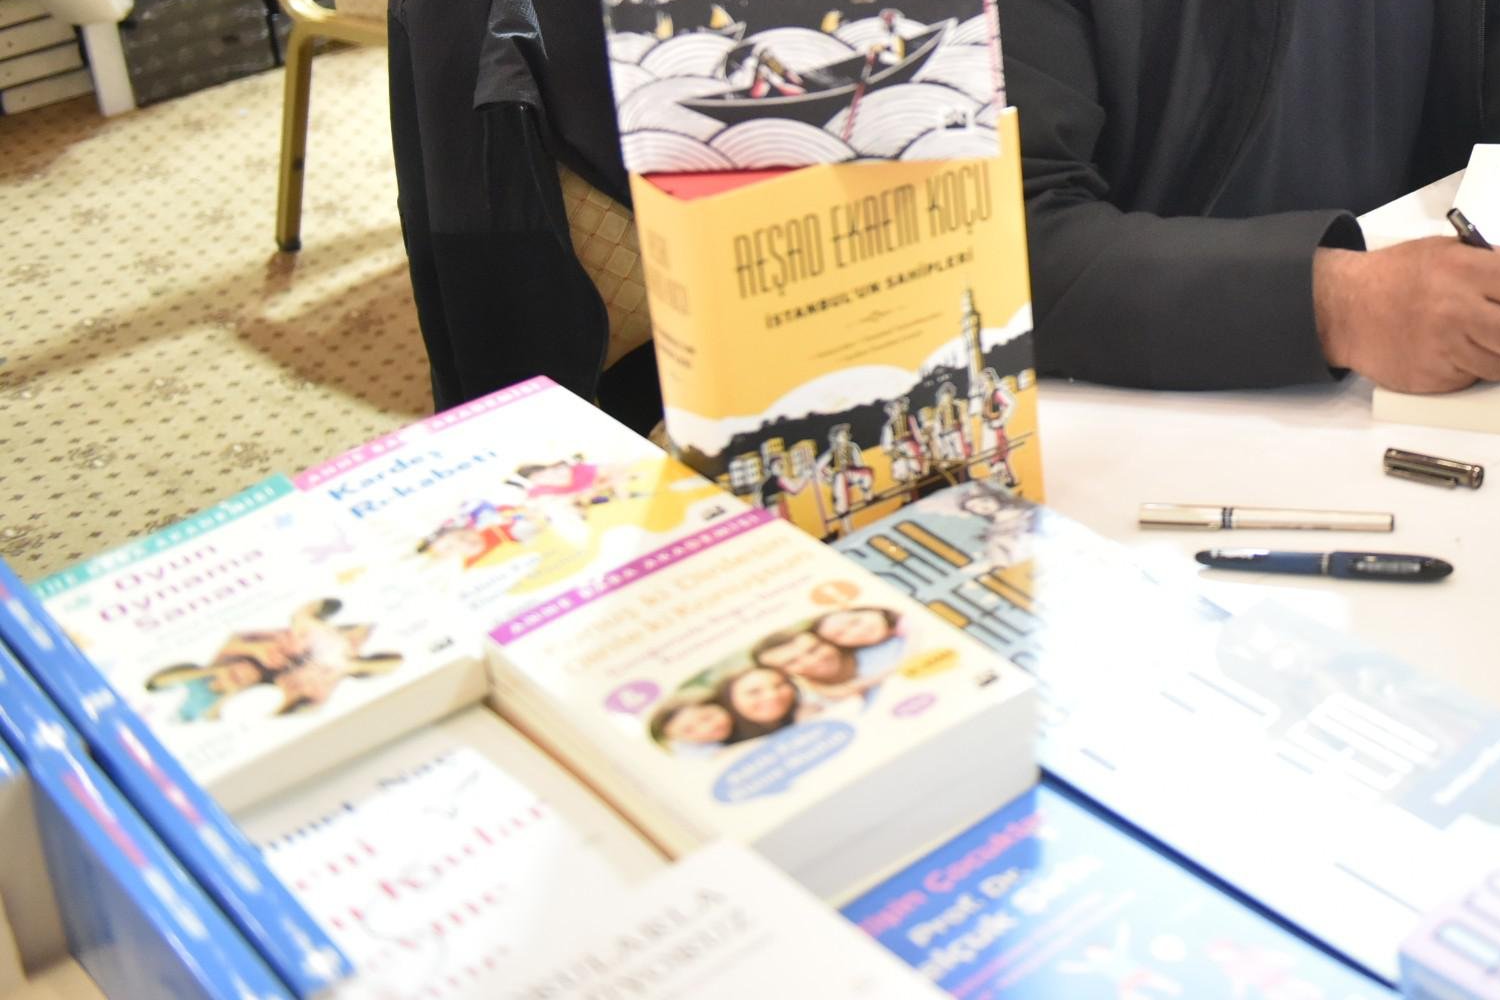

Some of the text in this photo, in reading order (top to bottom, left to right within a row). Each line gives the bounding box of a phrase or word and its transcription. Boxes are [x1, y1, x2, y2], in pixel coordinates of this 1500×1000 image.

[733, 212, 826, 299] REŞAD
[829, 186, 922, 267] EKREM
[924, 160, 993, 237] KOÇU
[885, 246, 976, 290] SAHİPLERİ
[98, 547, 265, 624] Oynama
[112, 544, 218, 593] Oyun
